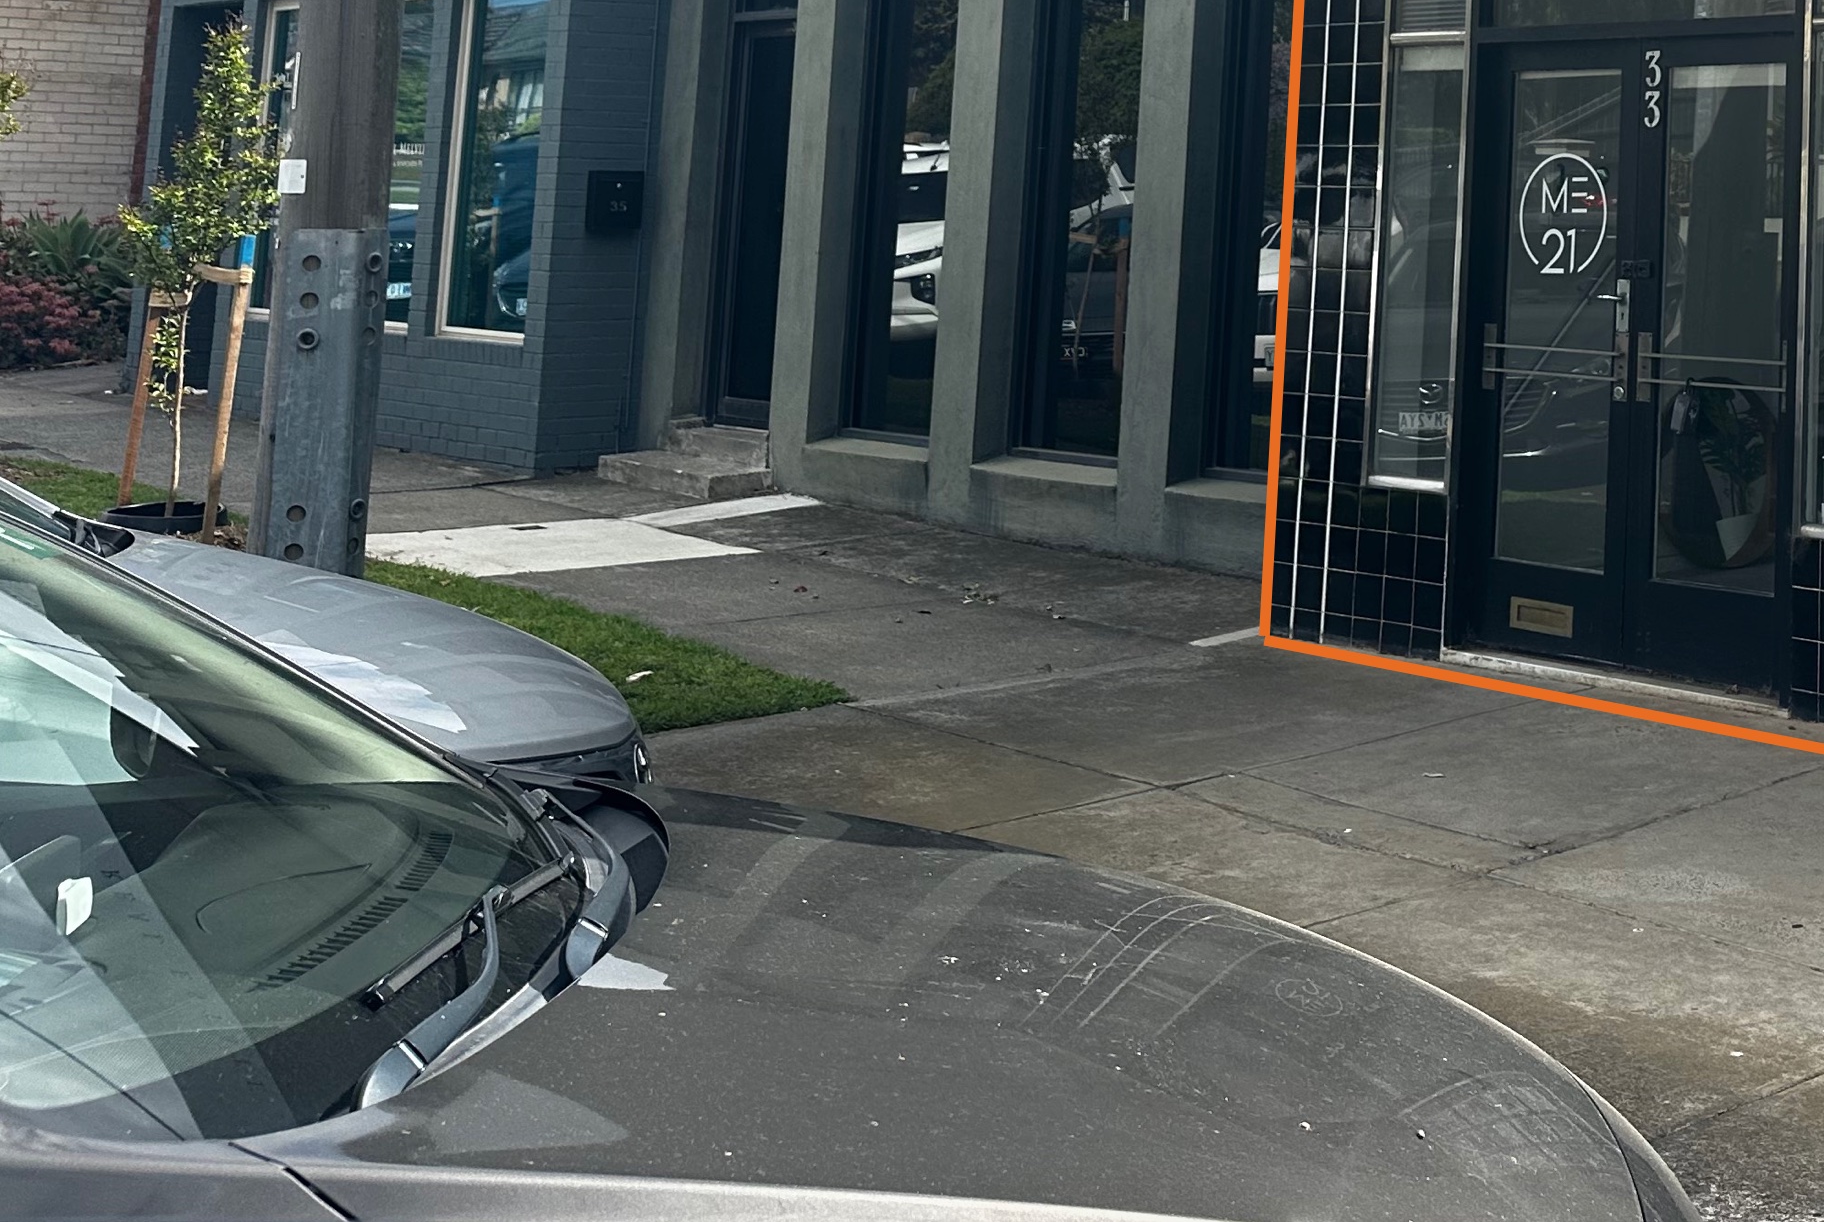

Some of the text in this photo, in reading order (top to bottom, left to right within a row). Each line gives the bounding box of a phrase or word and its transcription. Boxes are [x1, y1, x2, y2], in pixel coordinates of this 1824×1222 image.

[1644, 49, 1662, 128] 33
[609, 199, 628, 212] 35
[1541, 176, 1588, 214] ME
[1540, 228, 1577, 274] 21
